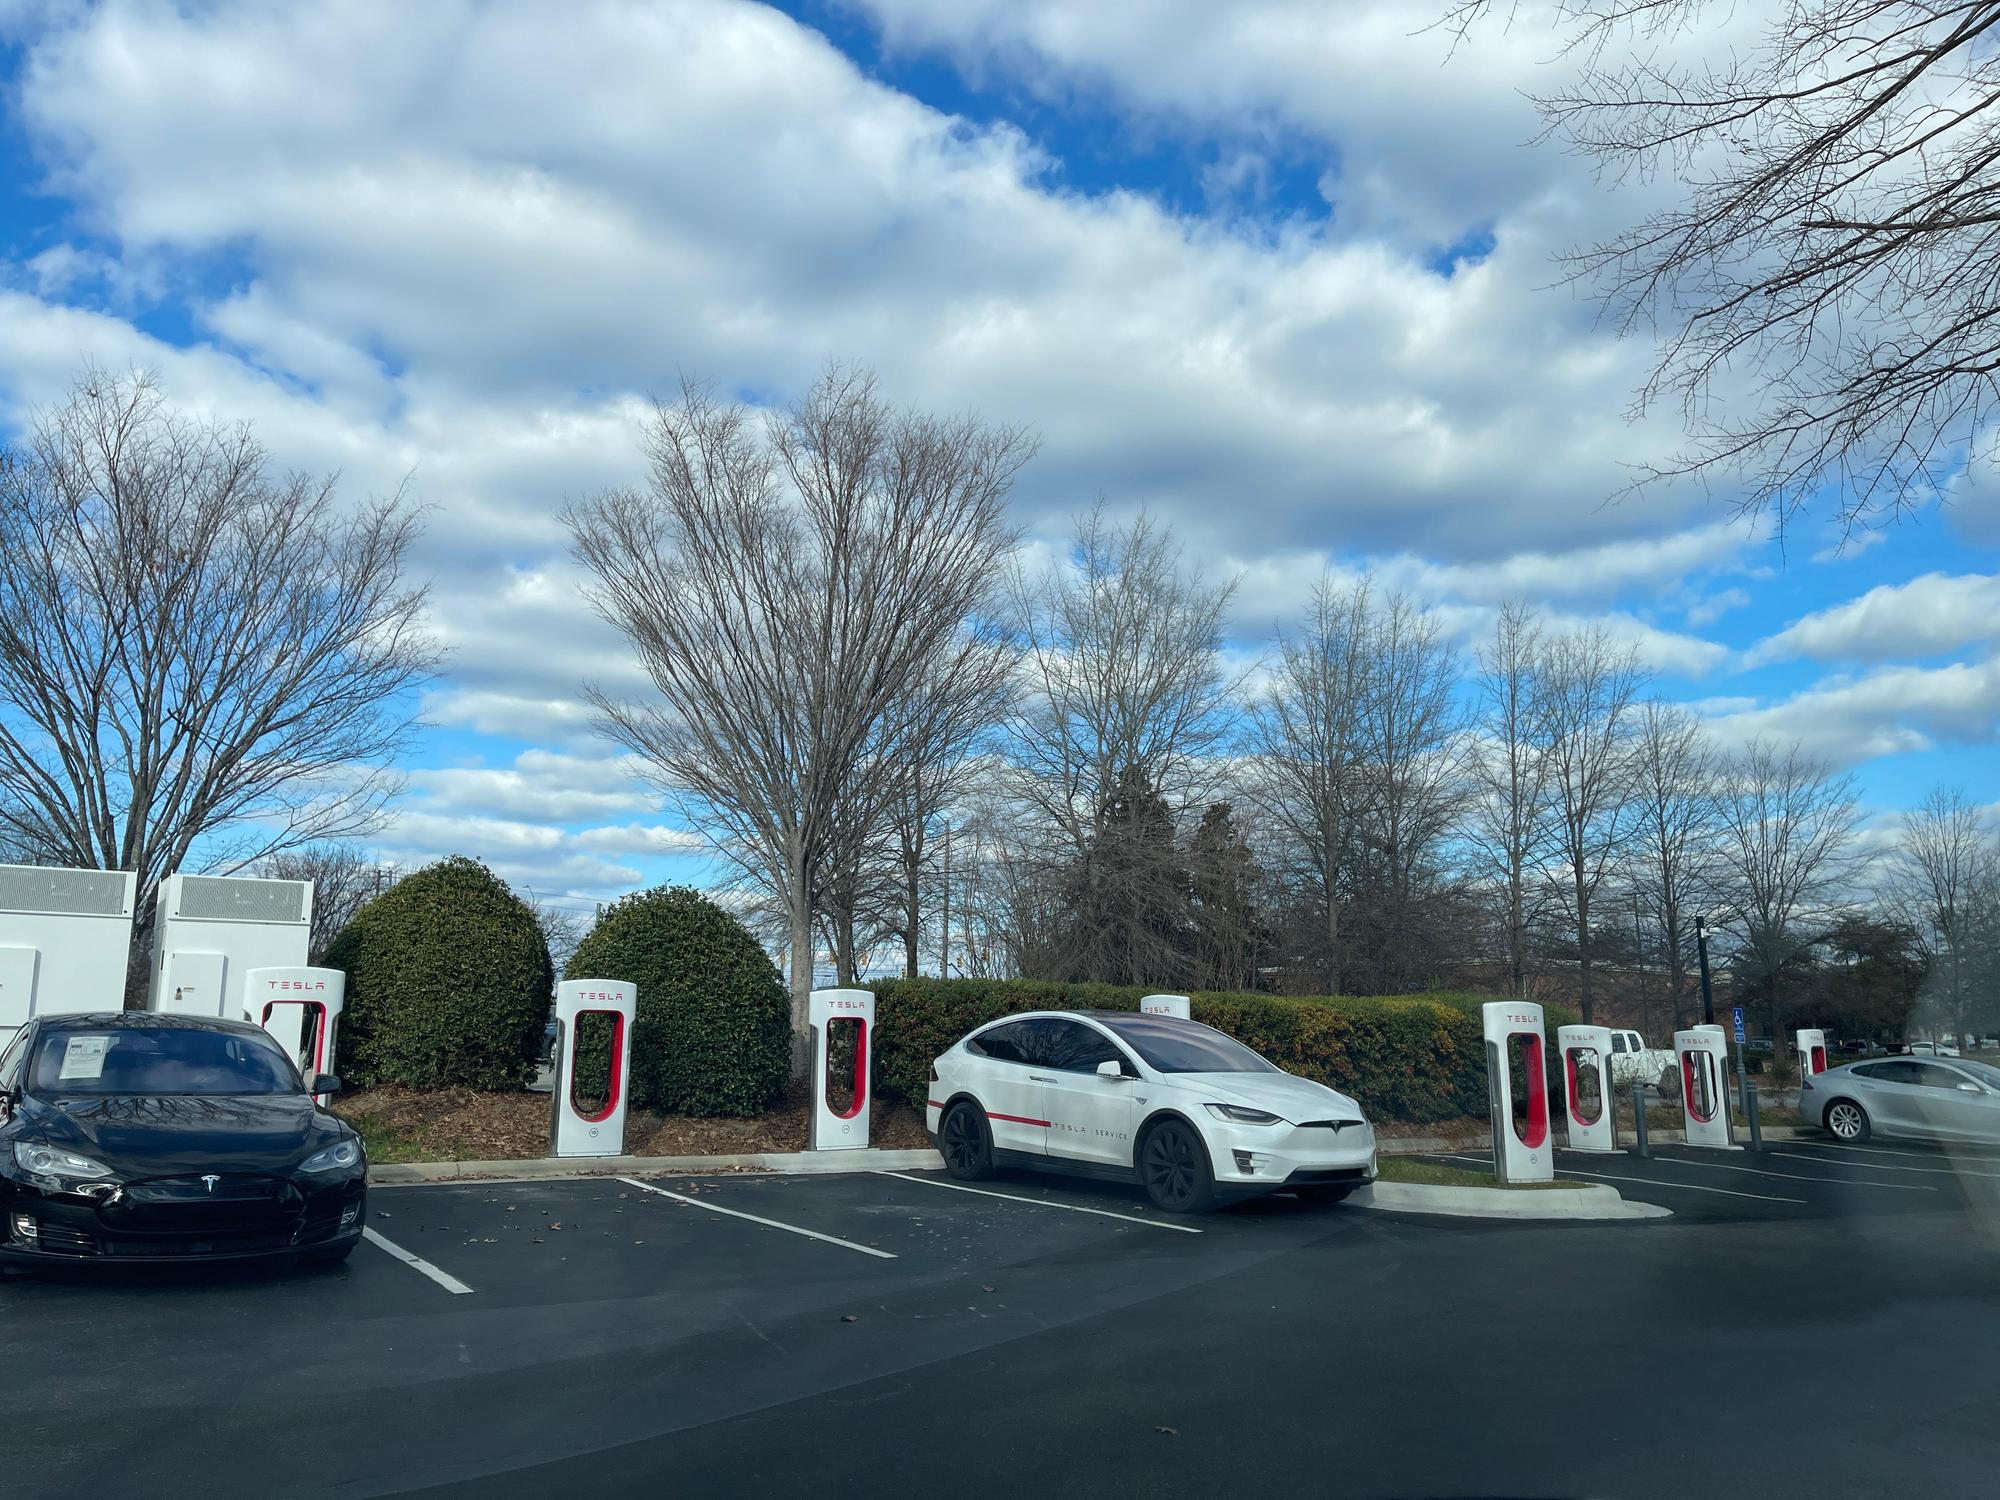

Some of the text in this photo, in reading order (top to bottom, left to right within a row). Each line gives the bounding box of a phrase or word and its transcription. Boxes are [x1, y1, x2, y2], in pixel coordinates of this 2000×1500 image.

[268, 981, 324, 989] TESLA
[578, 992, 623, 1001] TESLA
[1145, 1006, 1170, 1014] TESLA
[1054, 1122, 1128, 1140] TESLA SERVICE
